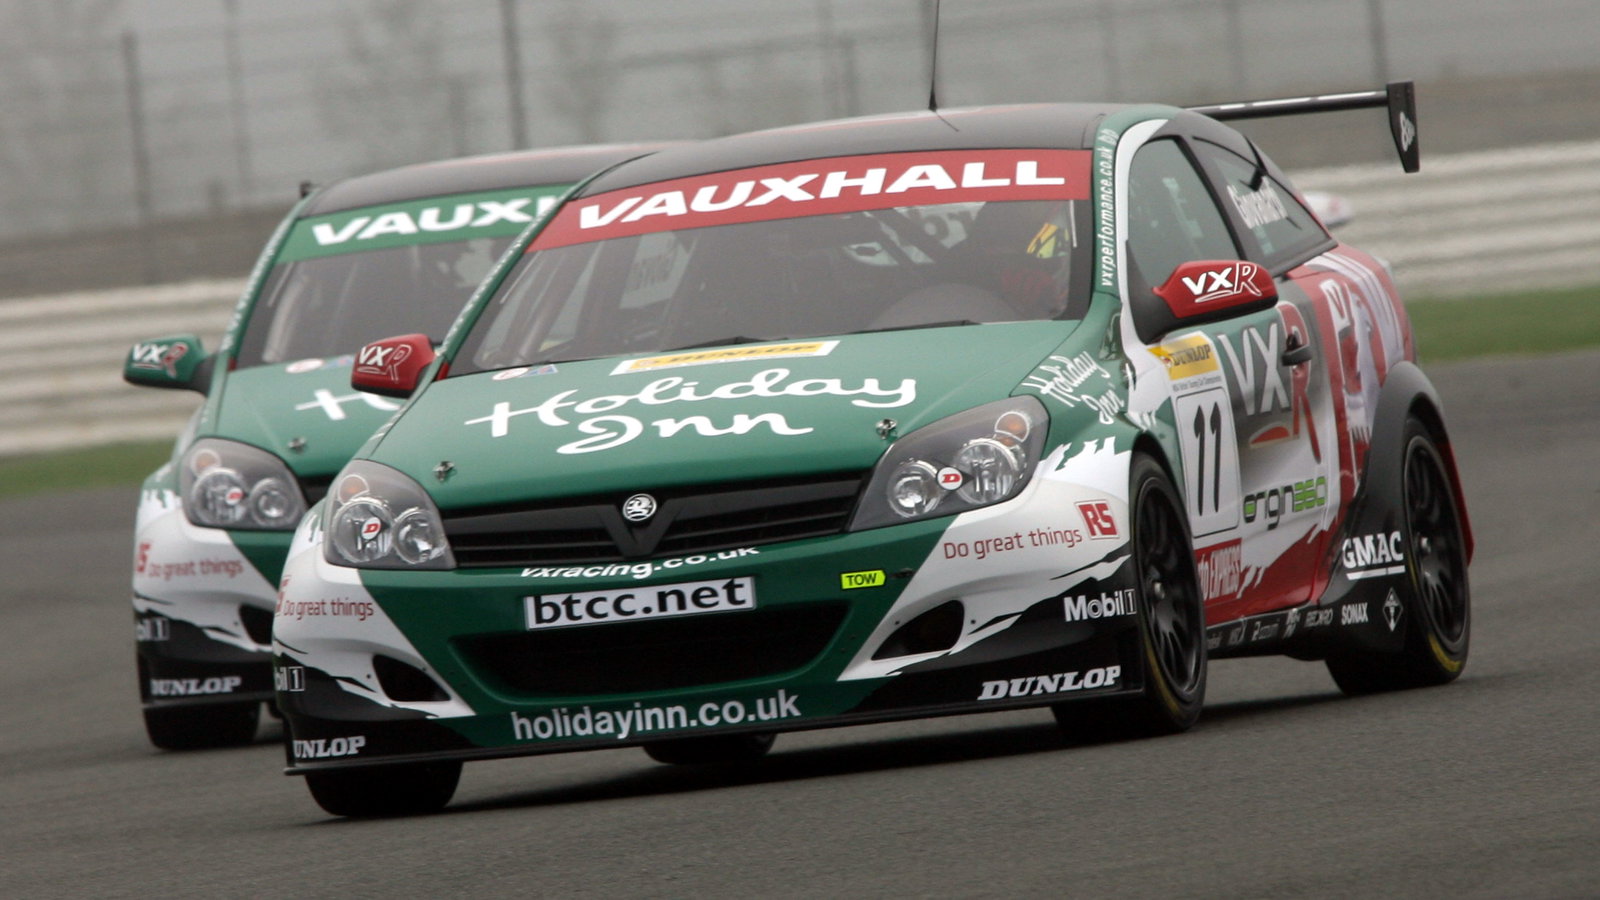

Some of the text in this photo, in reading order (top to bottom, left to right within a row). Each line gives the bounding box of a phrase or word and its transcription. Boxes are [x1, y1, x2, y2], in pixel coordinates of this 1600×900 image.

[579, 160, 1065, 228] VAUXHALL
[1098, 146, 1116, 287] vxrperformance.co.uk
[1181, 262, 1262, 303] VXR
[132, 342, 188, 379] VXR
[357, 344, 412, 383] VXR
[464, 368, 917, 438] Holiday
[1193, 401, 1224, 517] 11
[1078, 503, 1117, 536] RS
[943, 527, 1083, 559] Do great things
[1342, 531, 1404, 569] GMAC
[163, 561, 196, 581] great
[199, 558, 244, 579] things
[520, 547, 760, 579] vxracing.co.uk
[846, 573, 877, 587] TOW
[296, 599, 326, 621] great
[330, 597, 374, 621] things
[533, 578, 746, 624] btcc.net
[1063, 591, 1125, 622] Mobil
[1341, 602, 1368, 625] SONAX
[977, 665, 1121, 700] DUNLOP
[511, 689, 801, 741] holidayinn.co.uk
